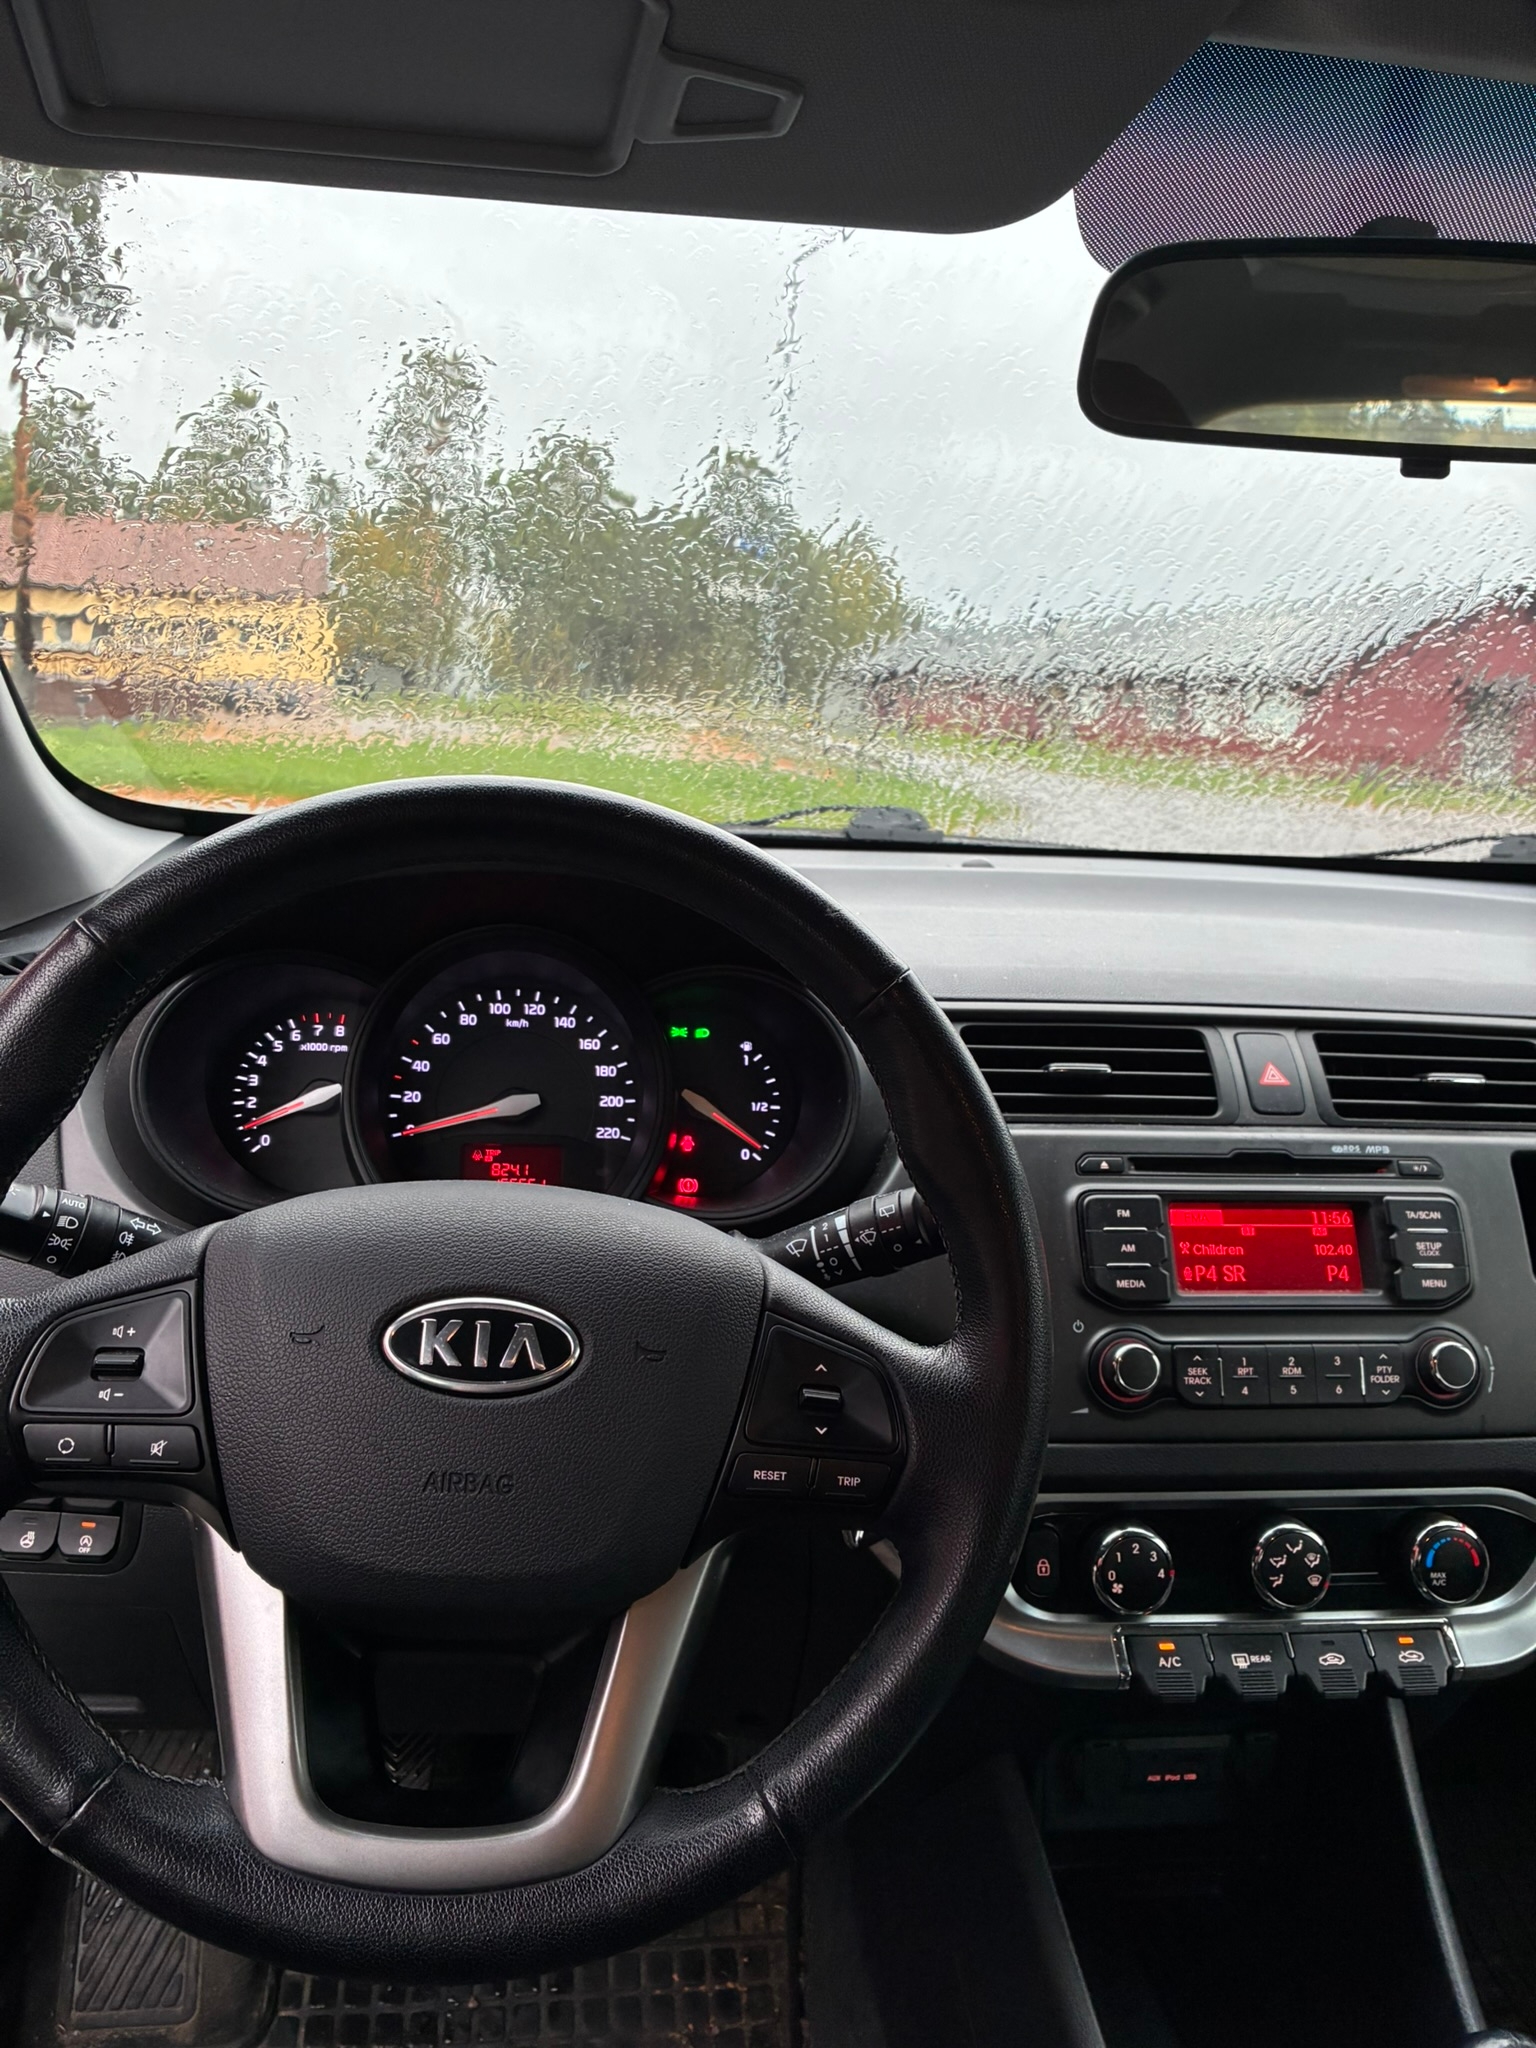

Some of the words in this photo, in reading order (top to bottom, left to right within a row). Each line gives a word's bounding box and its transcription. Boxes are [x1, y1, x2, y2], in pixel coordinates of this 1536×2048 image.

[489, 1002, 511, 1015] 100
[524, 1003, 546, 1016] 120
[459, 1013, 477, 1026] 80
[505, 1018, 529, 1029] km/h
[554, 1016, 576, 1029] 140
[290, 1030, 301, 1041] 6
[313, 1025, 323, 1036] 7
[334, 1025, 345, 1037] 8
[432, 1033, 450, 1046] 60
[579, 1038, 601, 1051] 160
[273, 1040, 283, 1052] 5
[300, 1042, 328, 1052] x1000
[330, 1044, 348, 1053] rpm
[257, 1055, 268, 1067] 4
[743, 1054, 750, 1066] 1
[412, 1060, 430, 1073] 40
[595, 1065, 617, 1078] 180
[248, 1074, 259, 1086] 3
[403, 1091, 421, 1103] 20
[600, 1096, 624, 1108] 200
[247, 1097, 258, 1109] 2
[751, 1102, 769, 1112] 1/2
[596, 1127, 620, 1139] 220
[260, 1134, 271, 1146] 0
[740, 1149, 750, 1161] 0
[62, 1198, 85, 1209] AUTO
[1116, 1209, 1131, 1218] FM
[1311, 1211, 1351, 1225] 11:56
[1405, 1210, 1442, 1220] TA/SCAN
[822, 1222, 829, 1231] 2
[824, 1234, 829, 1242] 1
[1120, 1244, 1136, 1253] AM
[1193, 1243, 1244, 1256] Children
[1314, 1244, 1353, 1256] 102.40
[1415, 1241, 1442, 1251] SETUP
[1195, 1265, 1218, 1282] P4
[1223, 1265, 1246, 1282] SR
[1327, 1265, 1349, 1282] P4
[1116, 1279, 1146, 1289] MEDIA
[1421, 1279, 1447, 1289] MENU
[420, 1319, 546, 1371] KIA
[1241, 1356, 1248, 1367] 1
[1288, 1356, 1296, 1367] 2
[1334, 1355, 1342, 1366] 3
[1187, 1367, 1209, 1377] SEEK
[1237, 1366, 1254, 1376] RPT
[1282, 1366, 1302, 1375] RDM
[1376, 1365, 1393, 1374] PTY
[1183, 1376, 1212, 1386] TRACK
[1370, 1374, 1400, 1384] FOLDER
[1241, 1386, 1250, 1396] 4
[1289, 1385, 1298, 1396] 5
[1335, 1385, 1343, 1395] 6
[752, 1470, 788, 1482] RESET
[836, 1475, 862, 1488] TRIP
[422, 1471, 515, 1497] AIRBAG
[1131, 1543, 1140, 1554] 2
[1115, 1552, 1122, 1563] 1
[1149, 1551, 1158, 1562] 3
[1107, 1570, 1116, 1581] 0
[1157, 1568, 1165, 1579] 4
[1159, 1656, 1182, 1667] A/C
[1250, 1655, 1272, 1663] REAR
